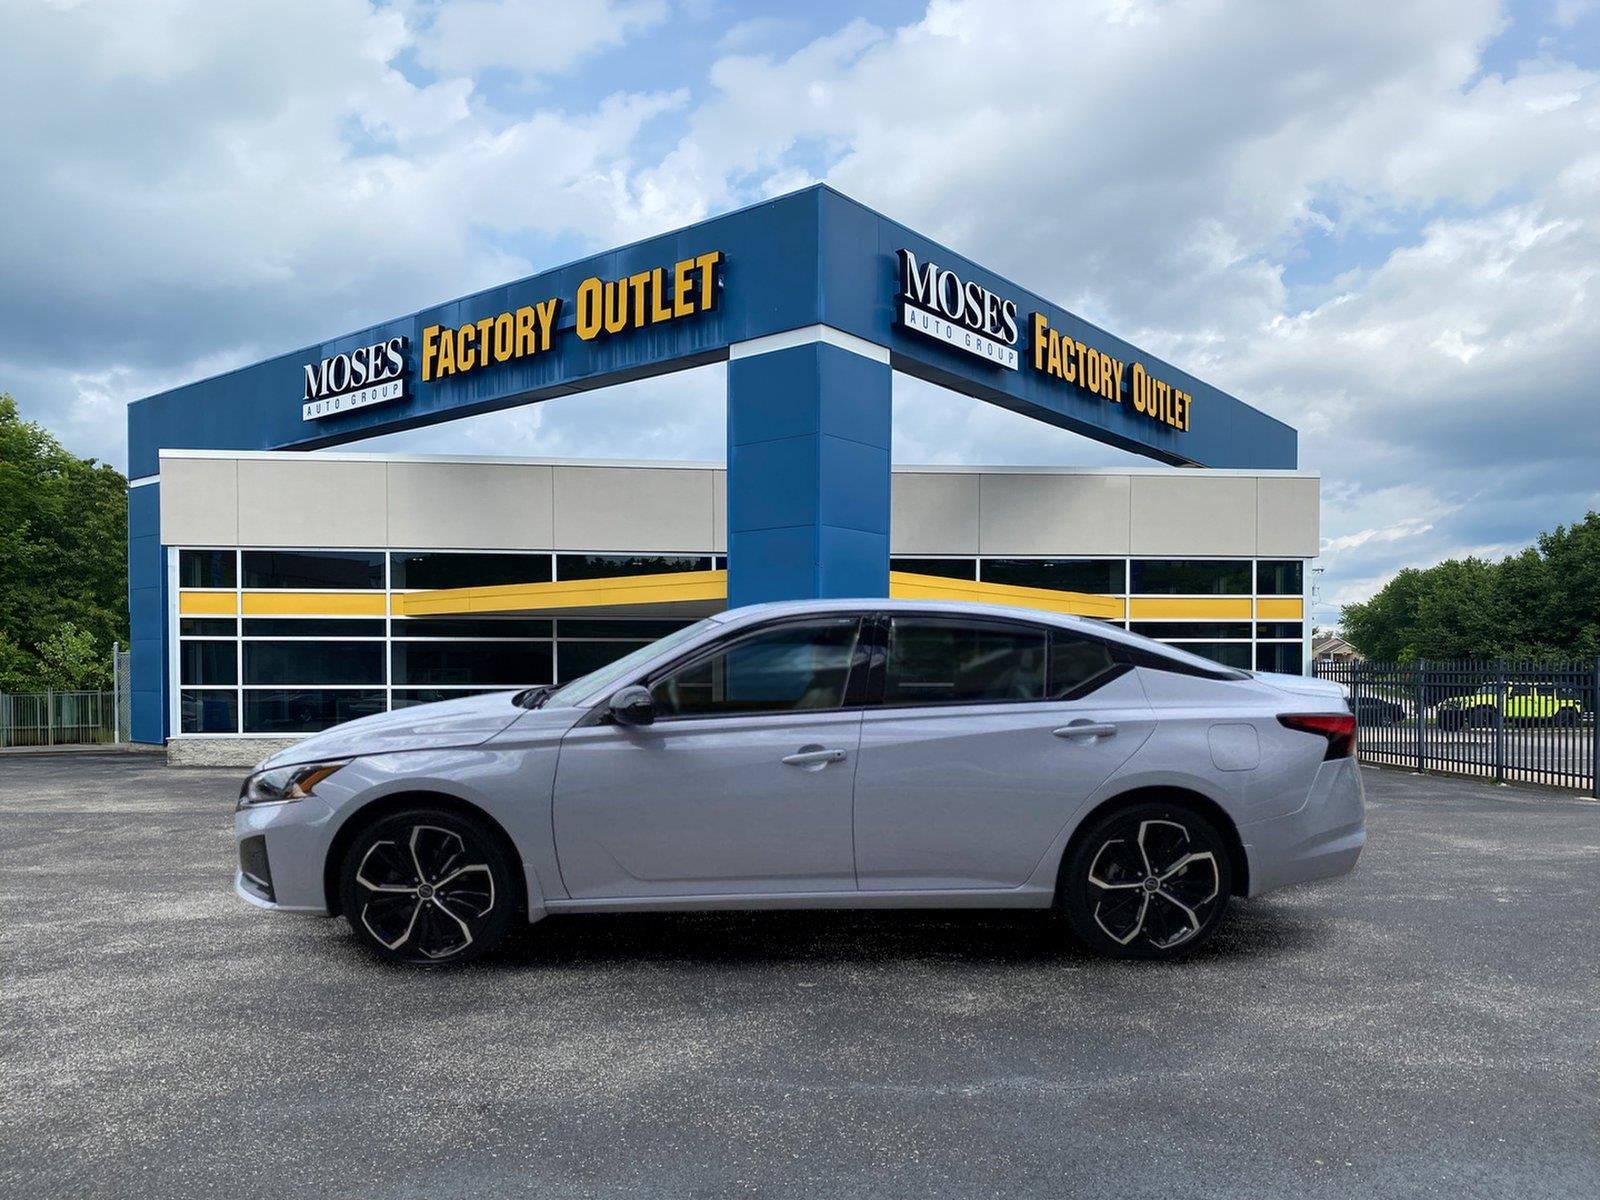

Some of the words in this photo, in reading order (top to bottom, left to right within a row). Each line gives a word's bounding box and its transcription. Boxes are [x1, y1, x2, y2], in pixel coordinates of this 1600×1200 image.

[421, 298, 559, 382] FACTORY
[576, 251, 720, 341] OUTLET
[904, 249, 1019, 345] MOSES
[303, 337, 404, 400] MOSES
[909, 310, 953, 339] AUTO
[964, 326, 1015, 364] GROUP
[1034, 312, 1124, 402] FACTORY
[1131, 362, 1192, 432] OUTLET
[306, 397, 341, 417] AUTO
[350, 383, 400, 406] GROUP
